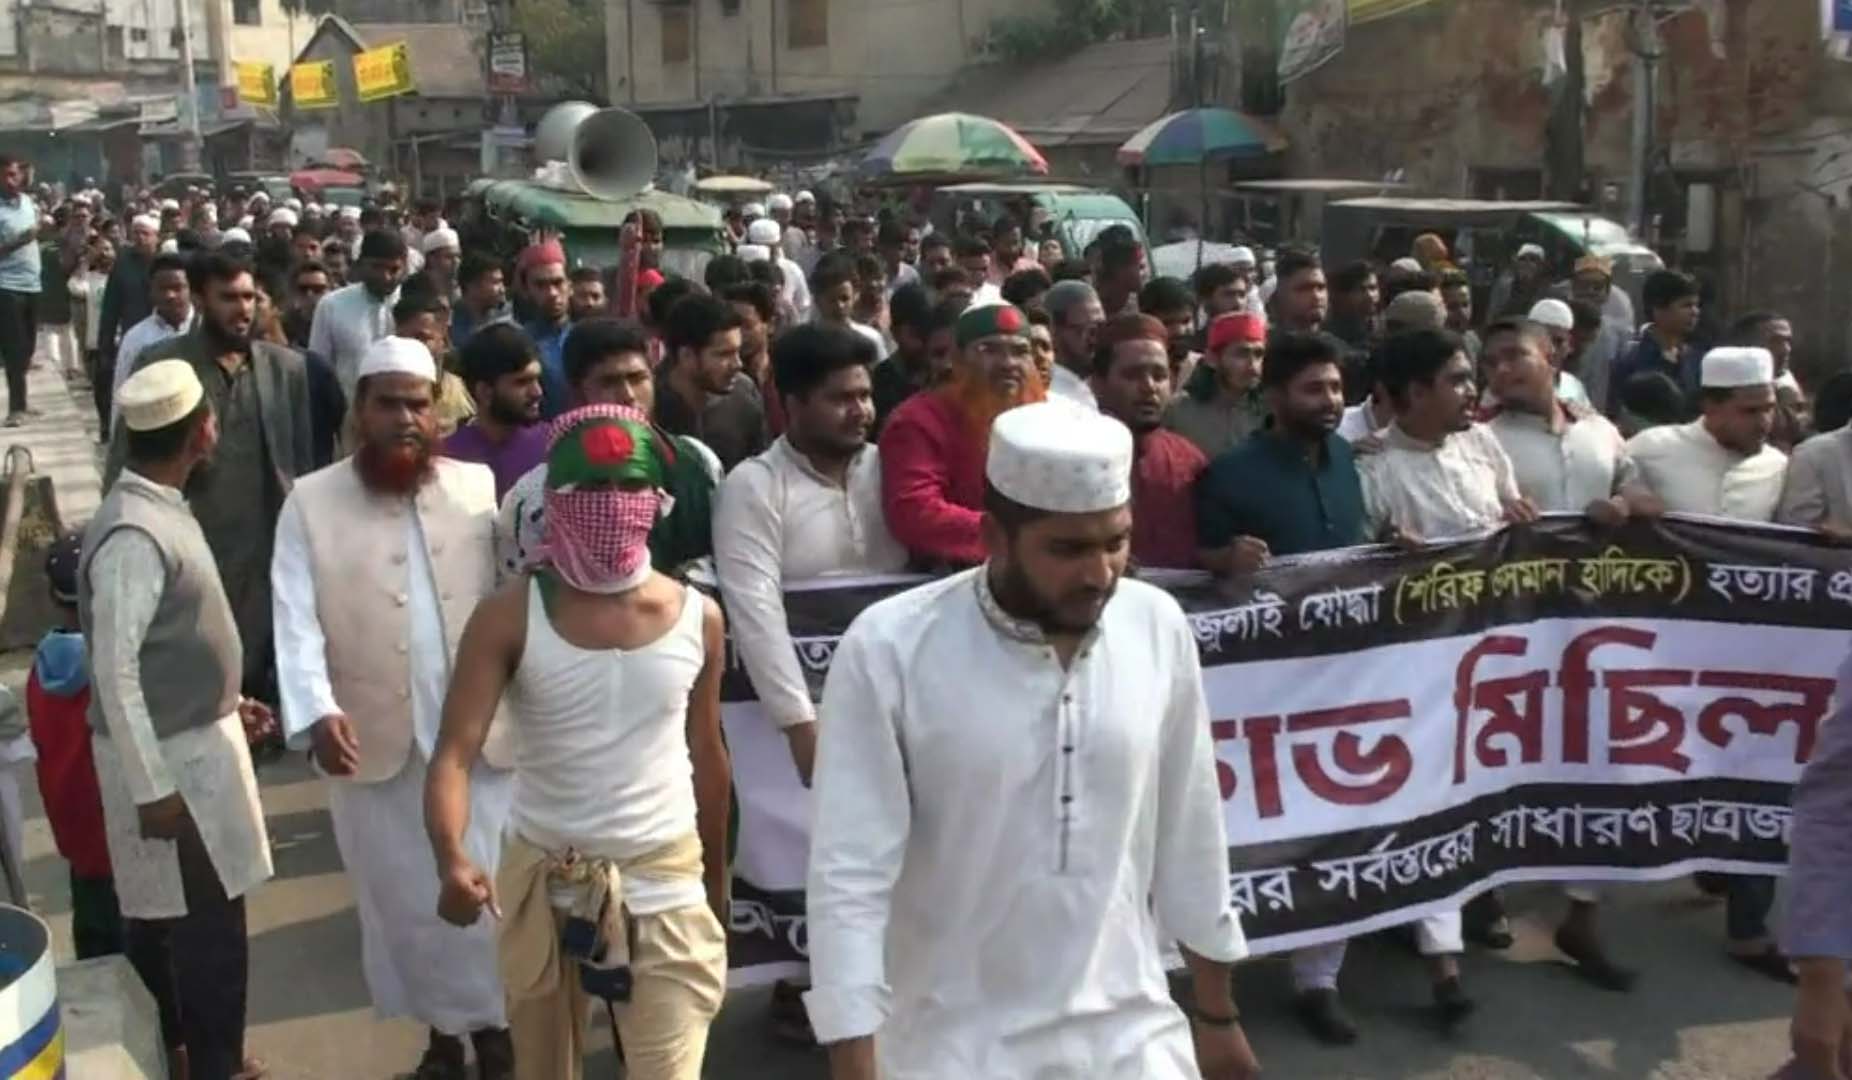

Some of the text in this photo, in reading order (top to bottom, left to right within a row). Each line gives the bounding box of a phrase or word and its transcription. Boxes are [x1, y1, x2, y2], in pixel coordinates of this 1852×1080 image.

[1187, 588, 1289, 652] জুলাই
[1300, 582, 1385, 631] যোদ্ধা
[1393, 561, 1487, 625] (শরিফ
[1706, 562, 1819, 603] হত্যার
[1452, 625, 1838, 785] মিছিল
[1311, 819, 1481, 901] সর্বস্তরের
[1489, 801, 1658, 849] সাধারণ
[1668, 797, 1793, 846] ছাত্রজ
